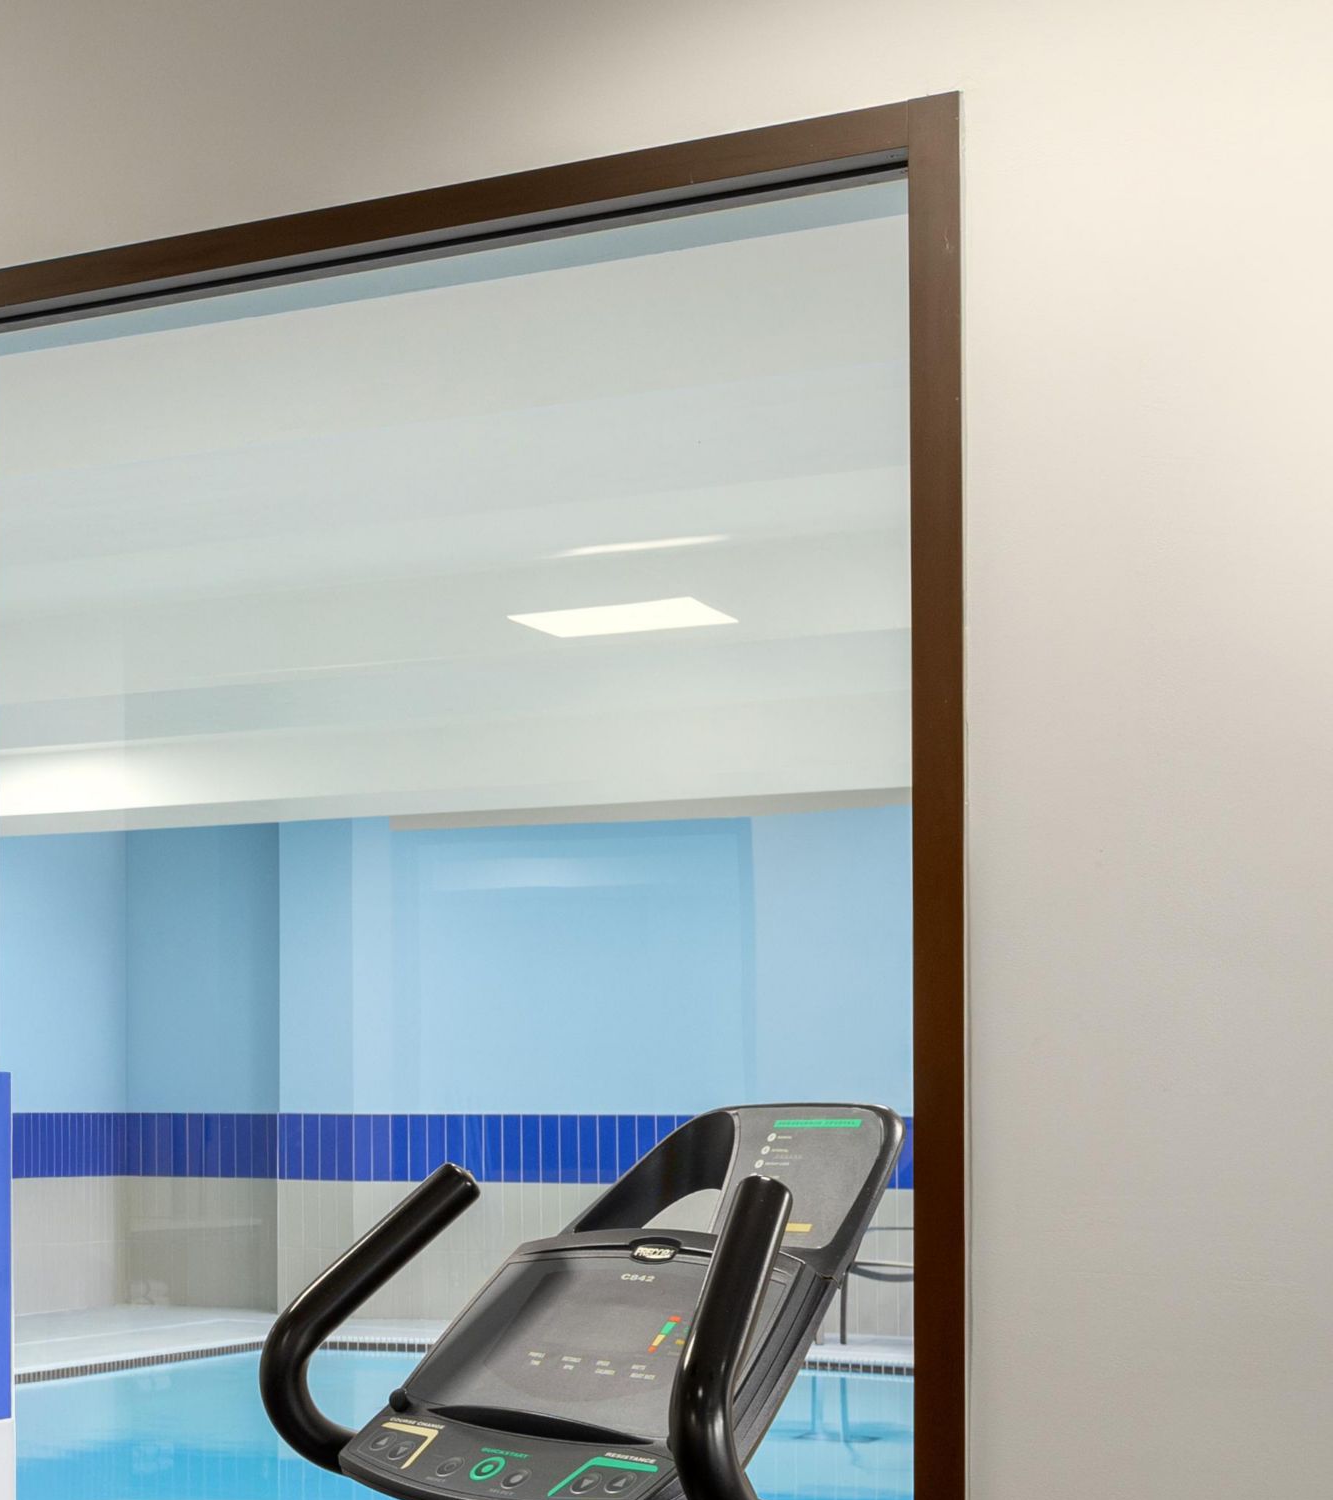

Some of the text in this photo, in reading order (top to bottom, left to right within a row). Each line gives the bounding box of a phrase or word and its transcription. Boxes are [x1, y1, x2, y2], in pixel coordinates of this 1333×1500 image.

[620, 1273, 656, 1283] C842
[480, 1446, 531, 1459] QUICKSTART
[604, 1451, 657, 1464] RESISTANCE
